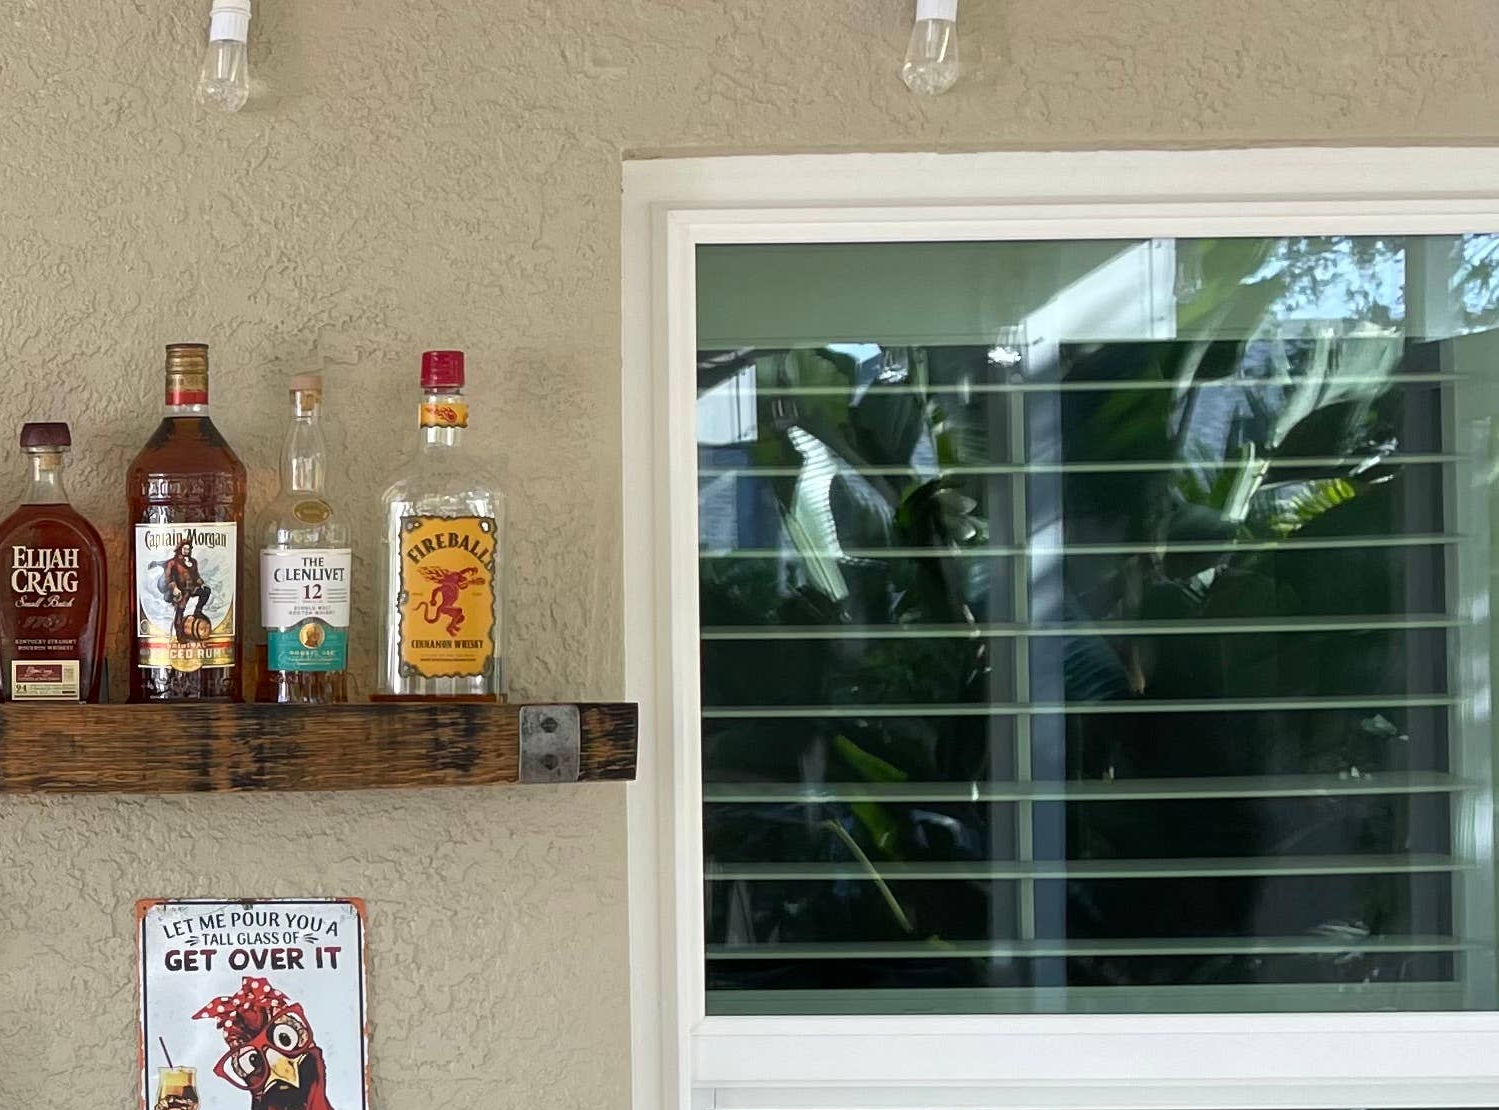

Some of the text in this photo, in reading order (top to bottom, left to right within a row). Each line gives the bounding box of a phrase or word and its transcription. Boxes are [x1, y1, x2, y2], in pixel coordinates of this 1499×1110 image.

[144, 528, 227, 550] Captain Morgan
[407, 532, 489, 565] FIREBALL
[11, 545, 80, 573] ELIJAH
[301, 556, 325, 567] THE
[11, 568, 79, 595] CRAIG
[274, 567, 345, 582] GLENLIVET
[303, 583, 323, 600] 12
[411, 639, 483, 649] CINNAMON WHISKY
[163, 911, 338, 939] LET ME POUR YOU A
[202, 931, 300, 946] TALL GLASS OF
[164, 946, 342, 971] GET OVER IT
